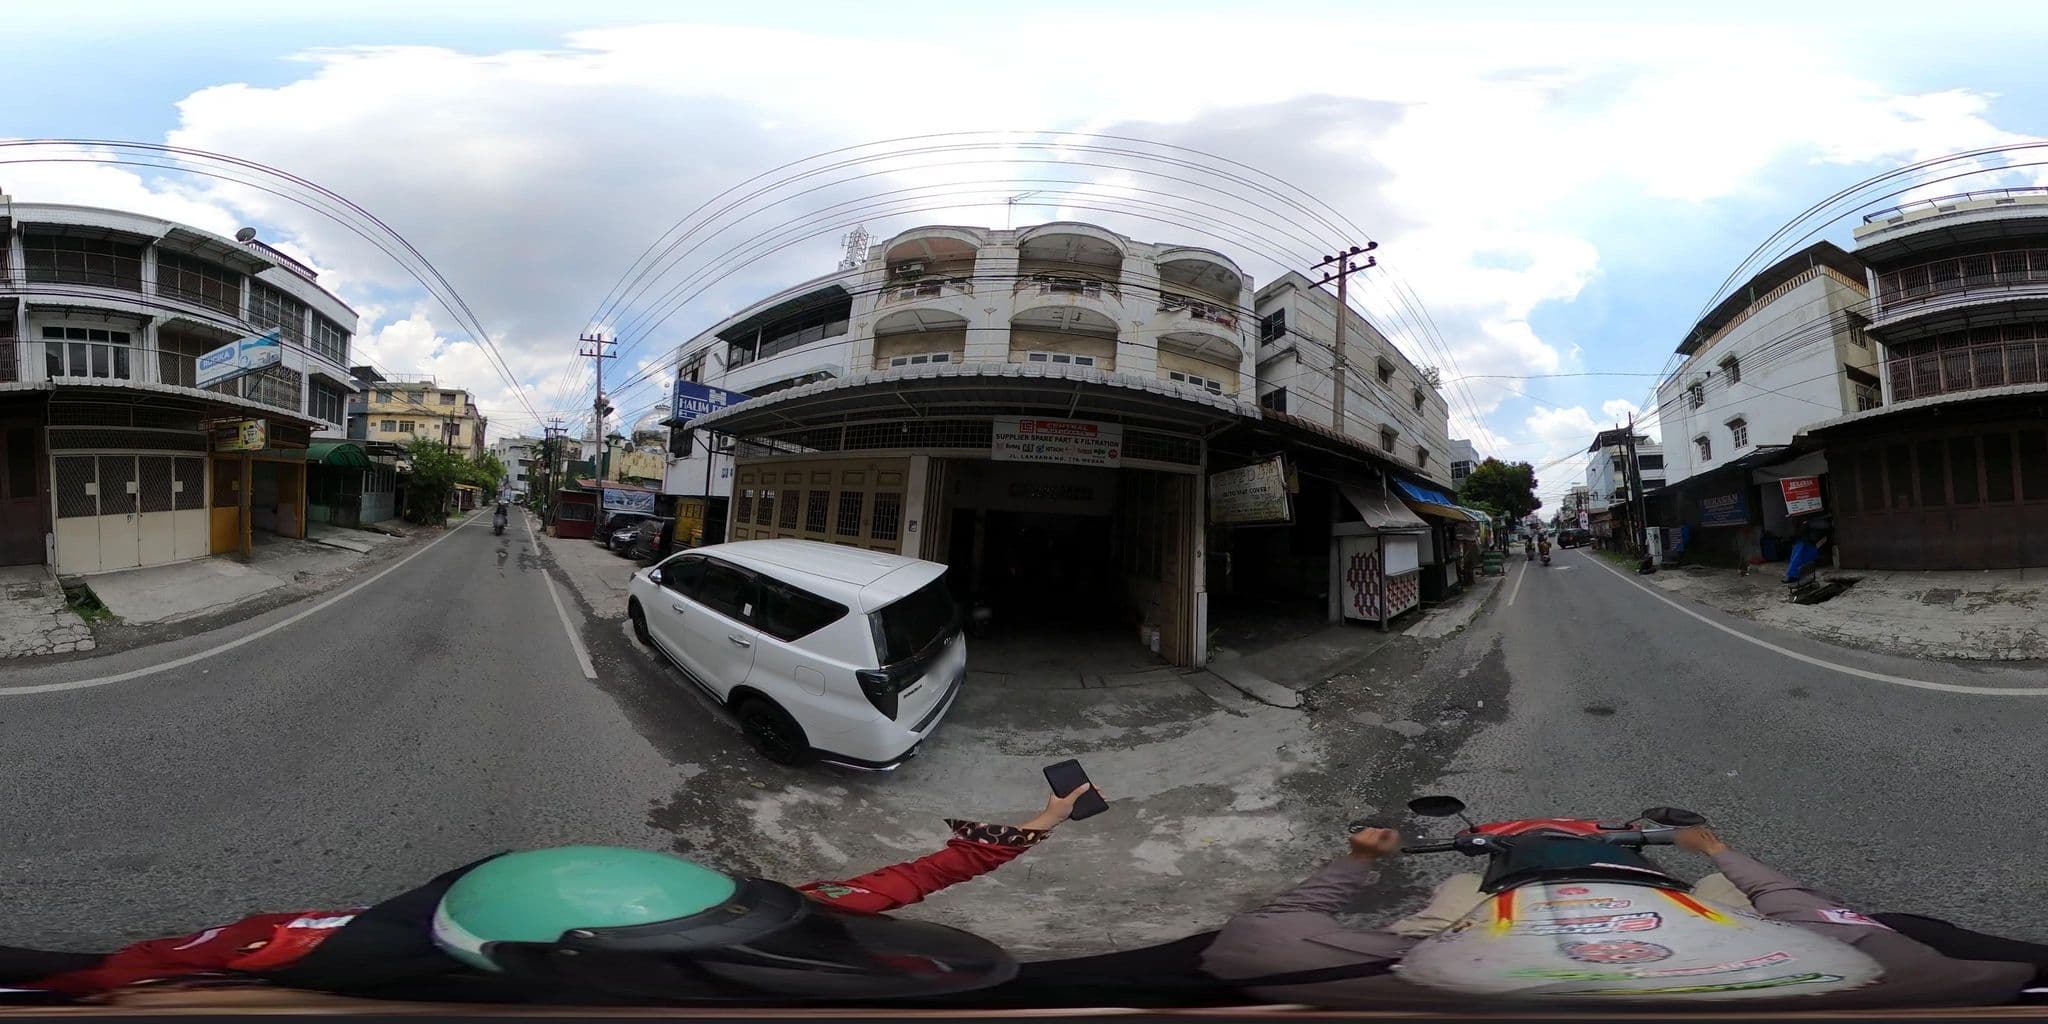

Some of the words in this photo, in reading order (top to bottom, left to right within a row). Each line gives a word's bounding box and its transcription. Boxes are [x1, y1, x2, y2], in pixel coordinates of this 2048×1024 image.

[679, 398, 709, 413] HALIM
[995, 433, 1029, 441] SUPPLIER
[1080, 439, 1119, 447] FILTRATION
